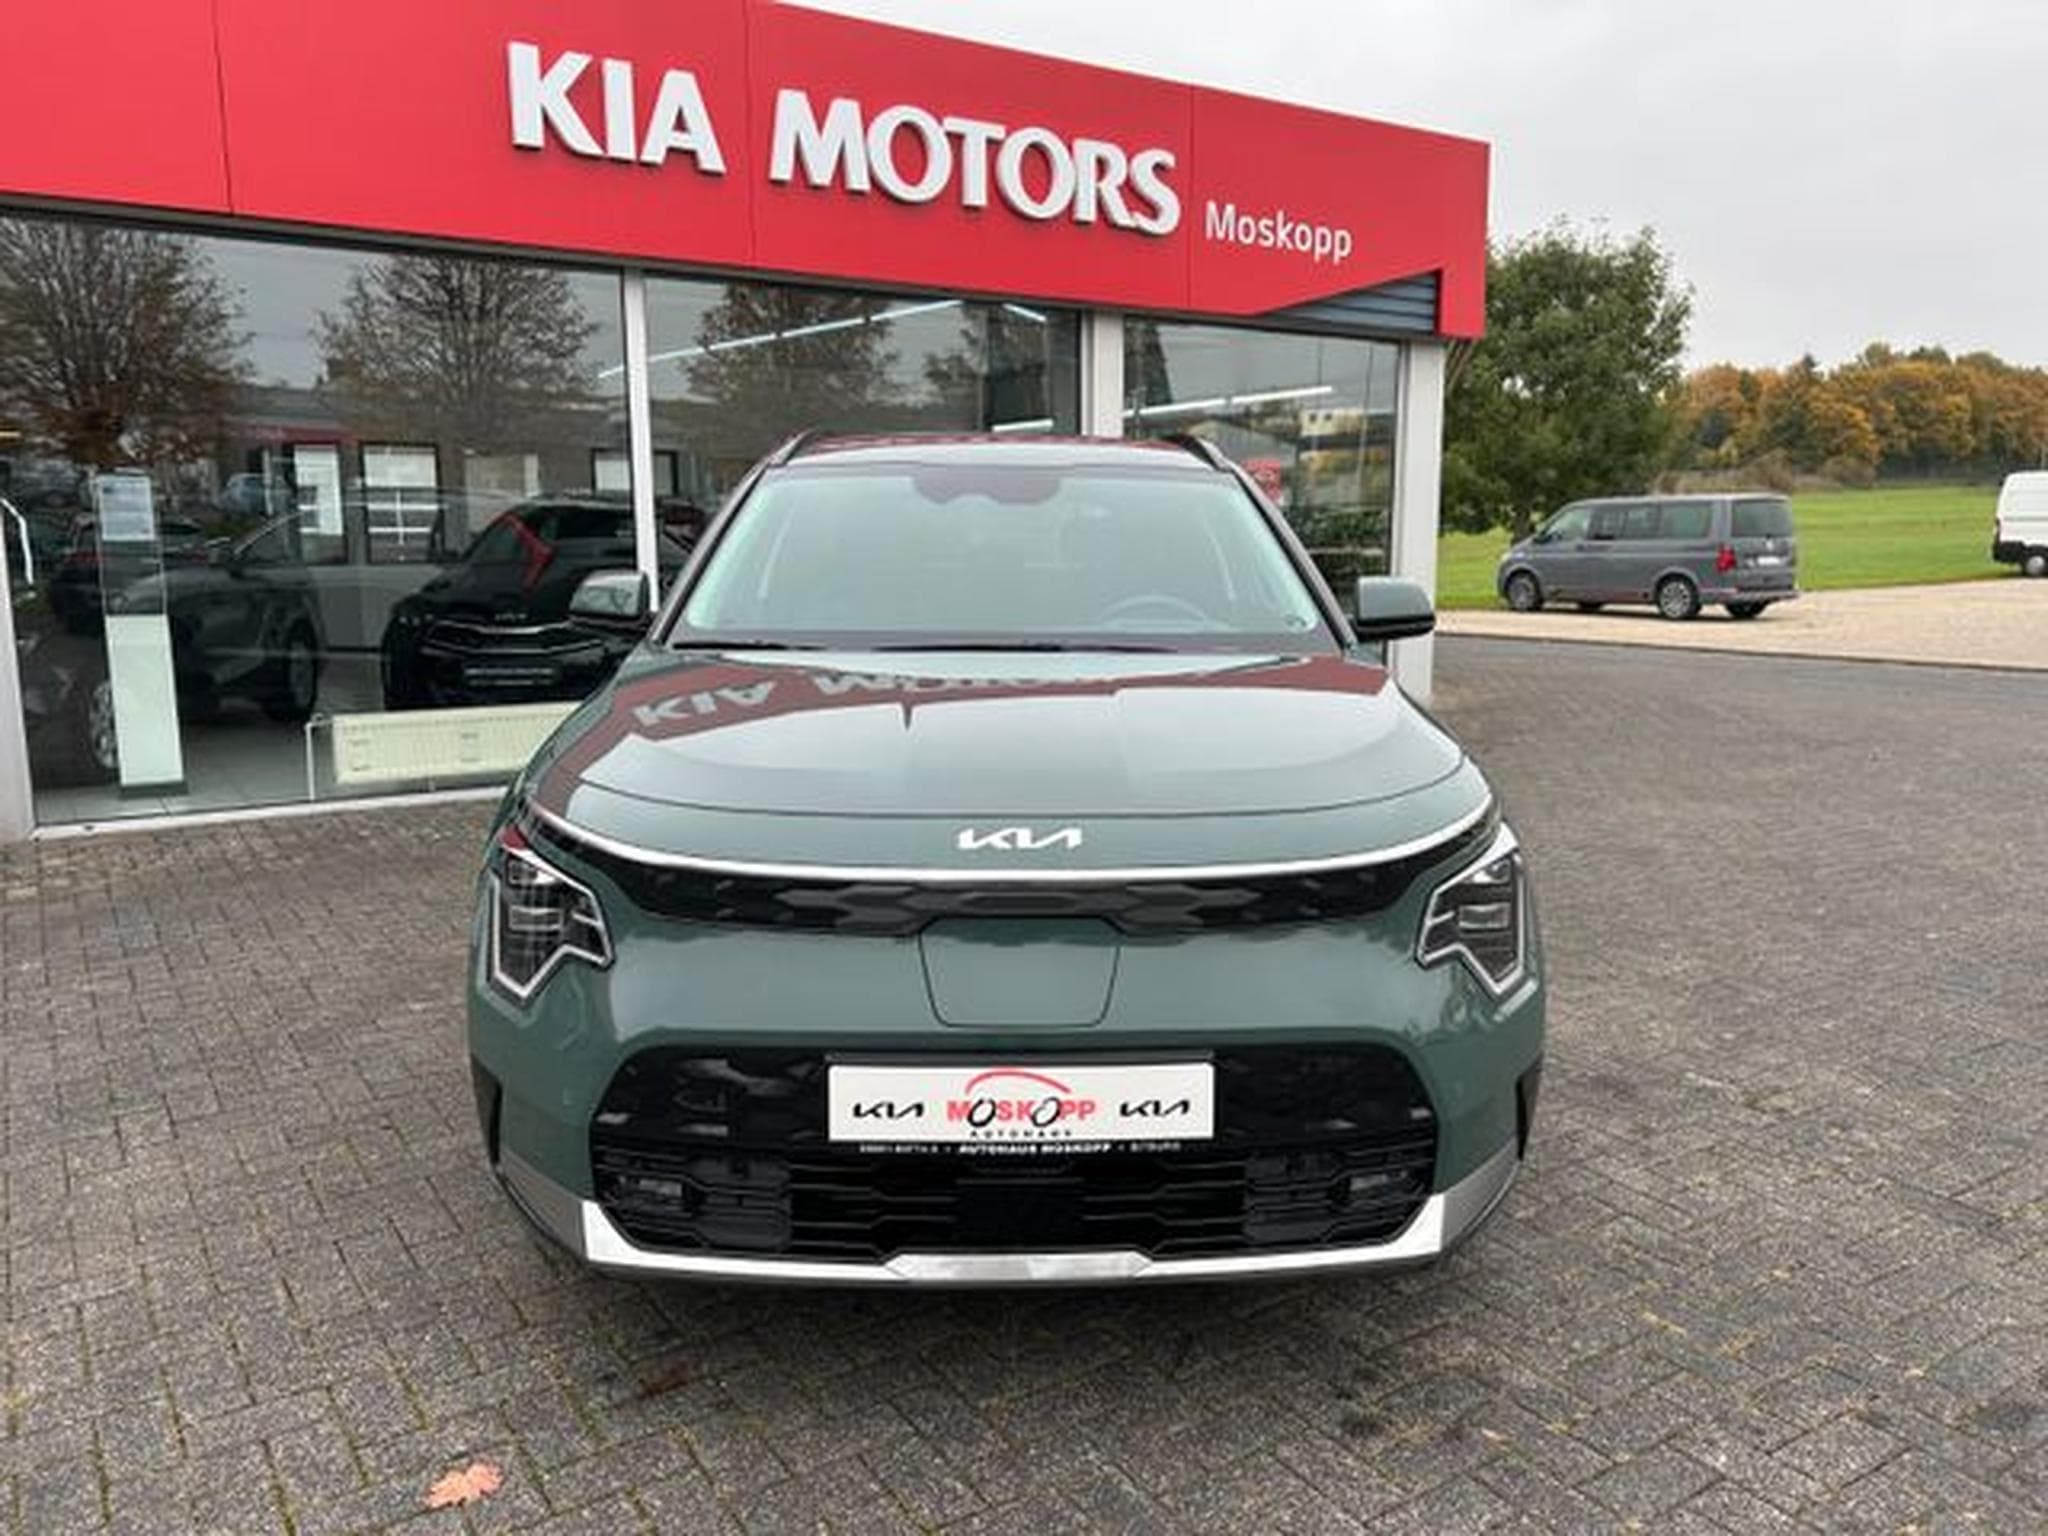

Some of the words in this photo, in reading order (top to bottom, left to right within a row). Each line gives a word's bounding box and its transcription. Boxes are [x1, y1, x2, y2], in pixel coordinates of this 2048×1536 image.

[508, 41, 726, 173] KIA
[769, 89, 1181, 235] MOTORS
[1206, 200, 1352, 264] Moskopp
[959, 828, 1082, 849] KIA
[853, 1101, 925, 1119] KIA
[947, 1097, 1096, 1127] MOSKOPP
[1119, 1100, 1190, 1117] KIA
